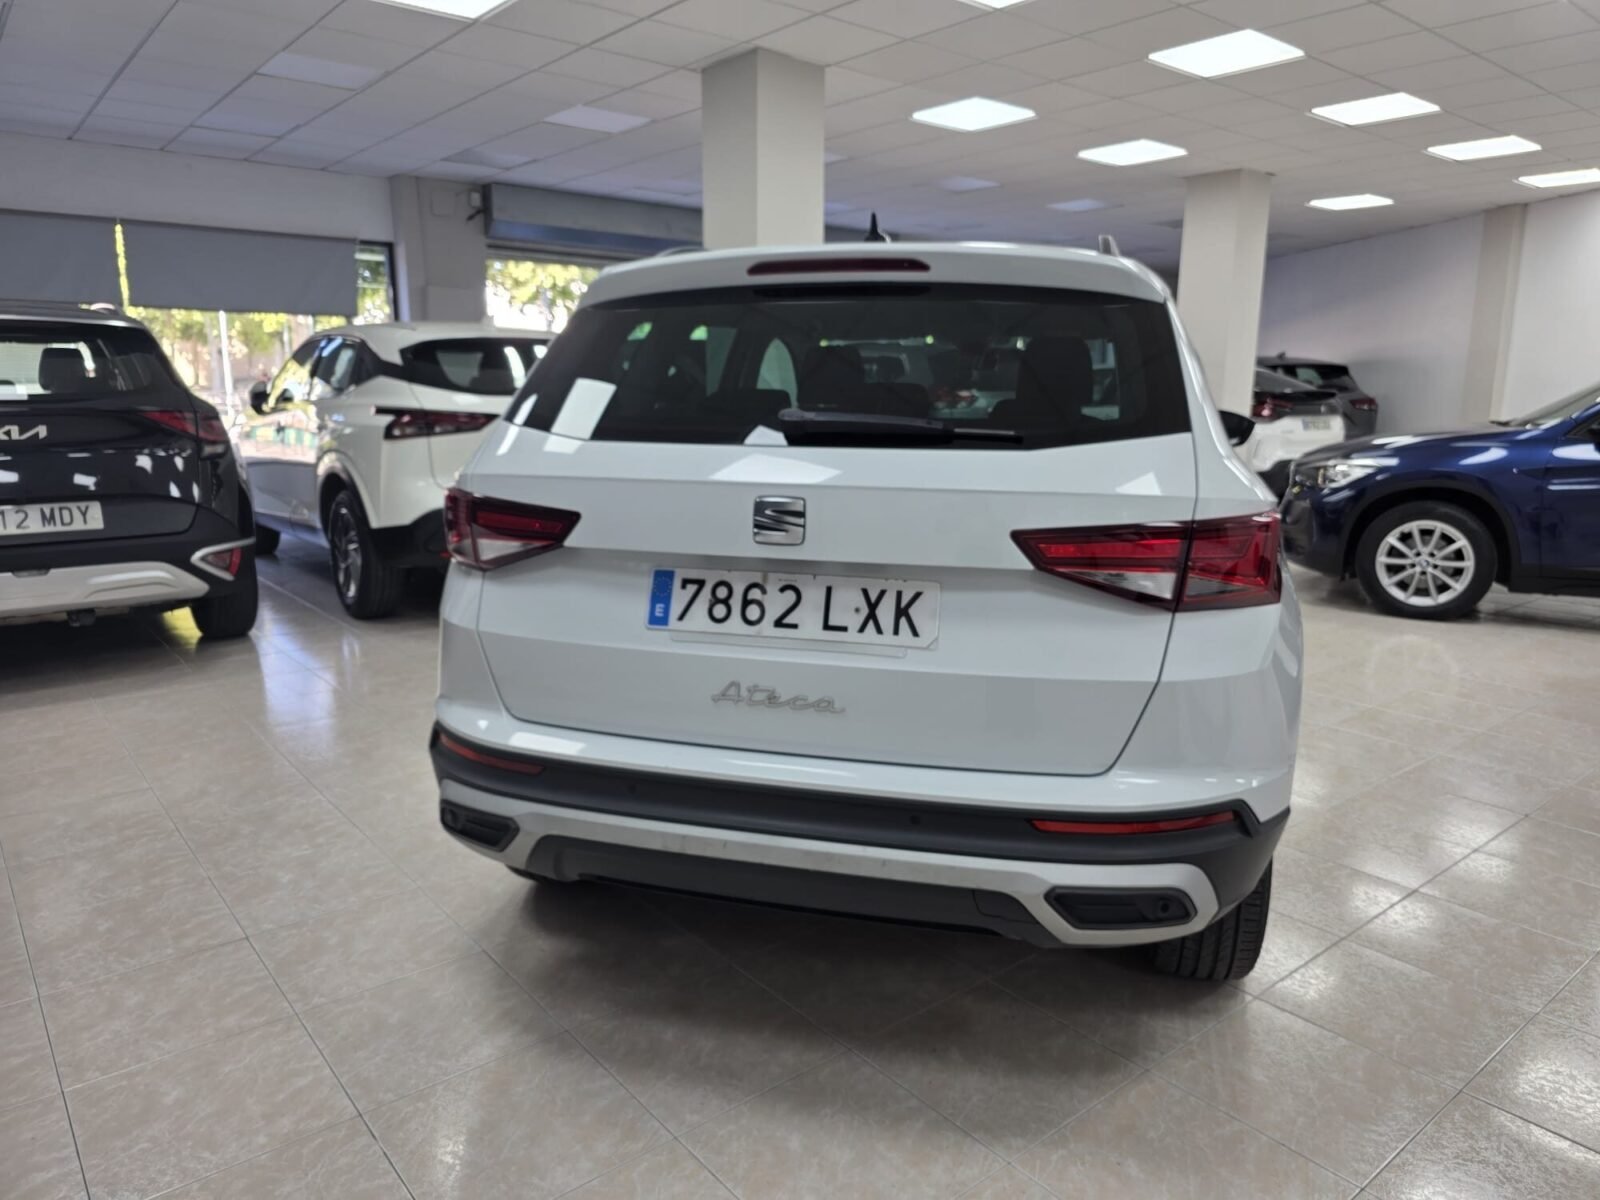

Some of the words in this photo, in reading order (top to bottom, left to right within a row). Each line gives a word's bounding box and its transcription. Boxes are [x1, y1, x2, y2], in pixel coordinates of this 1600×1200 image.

[40, 504, 90, 528] MDY
[655, 603, 666, 617] E
[676, 578, 803, 630] 7862
[822, 585, 924, 638] LXK
[711, 680, 846, 714] Ateca
